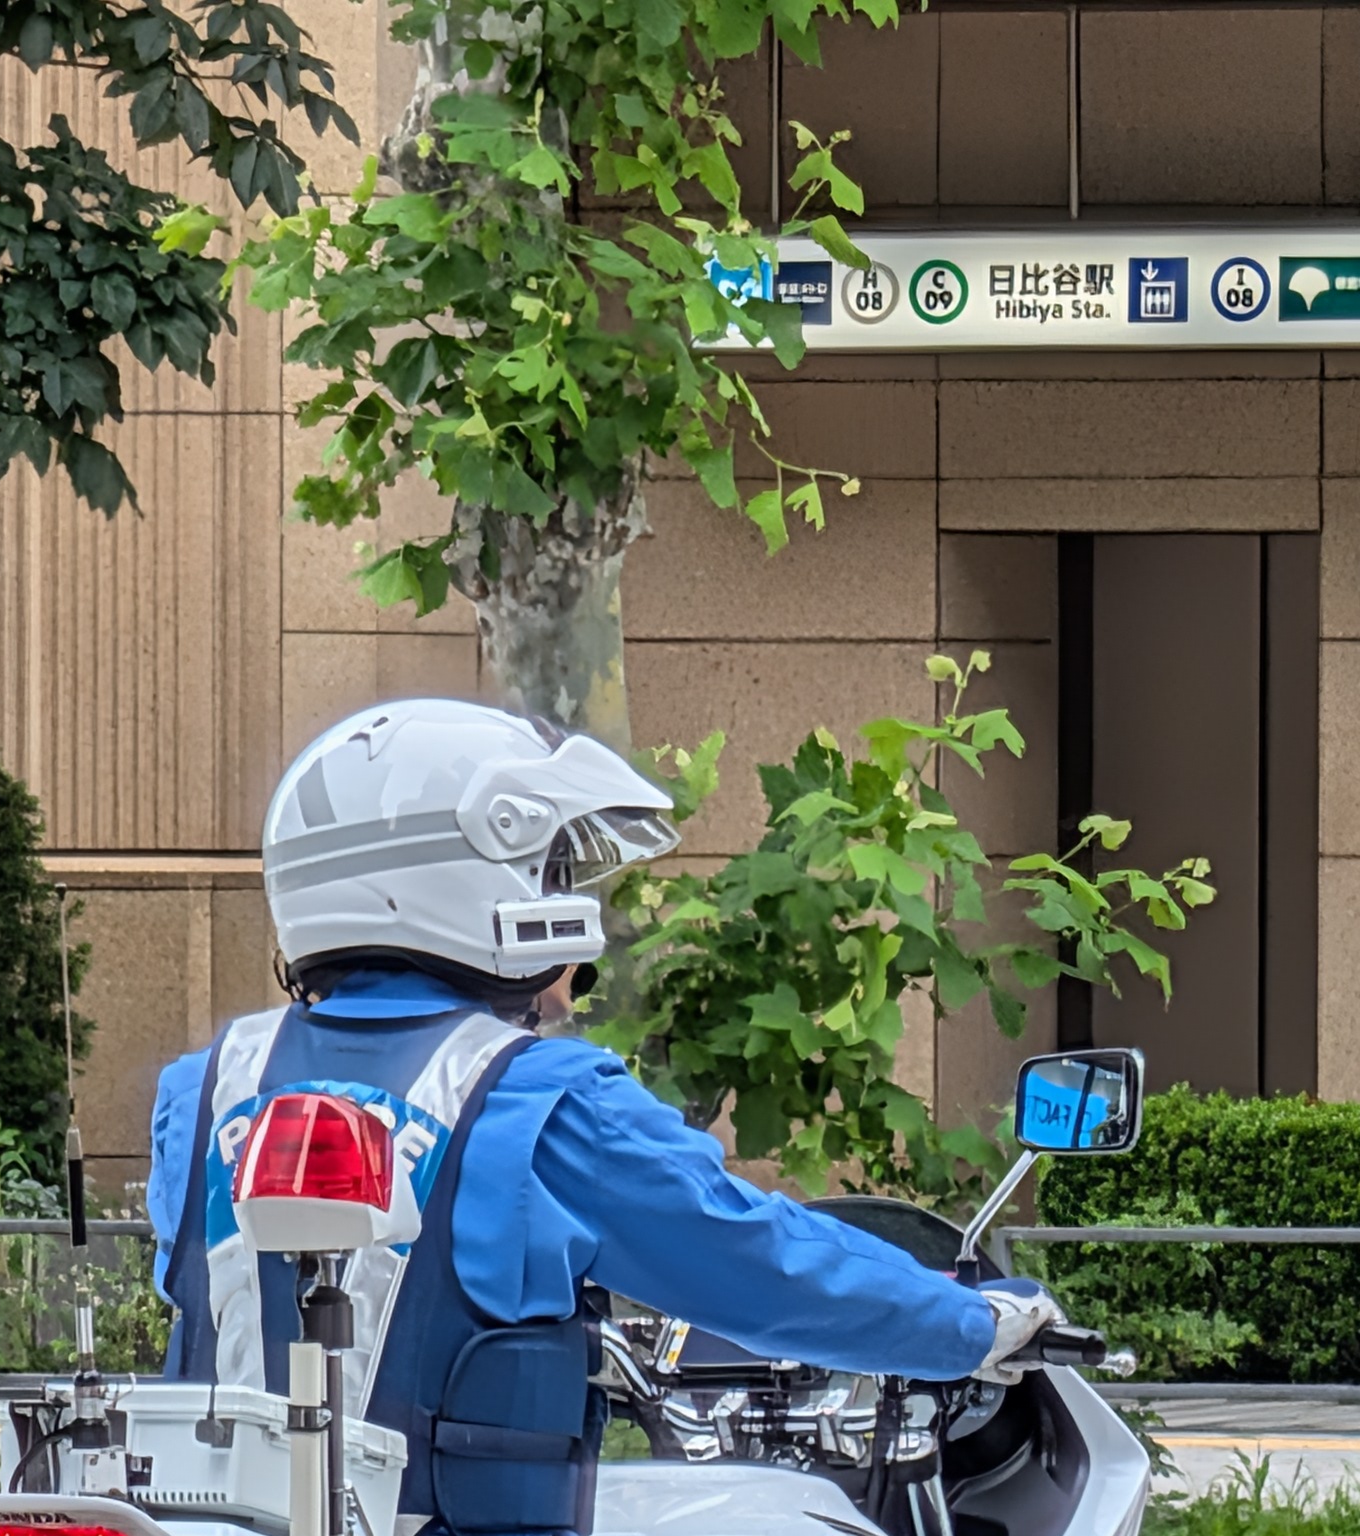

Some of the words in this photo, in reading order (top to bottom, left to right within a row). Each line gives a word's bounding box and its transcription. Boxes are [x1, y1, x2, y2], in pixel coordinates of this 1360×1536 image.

[863, 269, 878, 289] H
[932, 270, 946, 289] C
[989, 262, 1115, 296] 日比谷駅
[1237, 268, 1245, 286] I
[856, 291, 883, 311] 08
[925, 291, 953, 311] 09
[1226, 288, 1253, 307] 08
[995, 299, 1063, 324] Hibiya
[1071, 299, 1111, 319] Sta.
